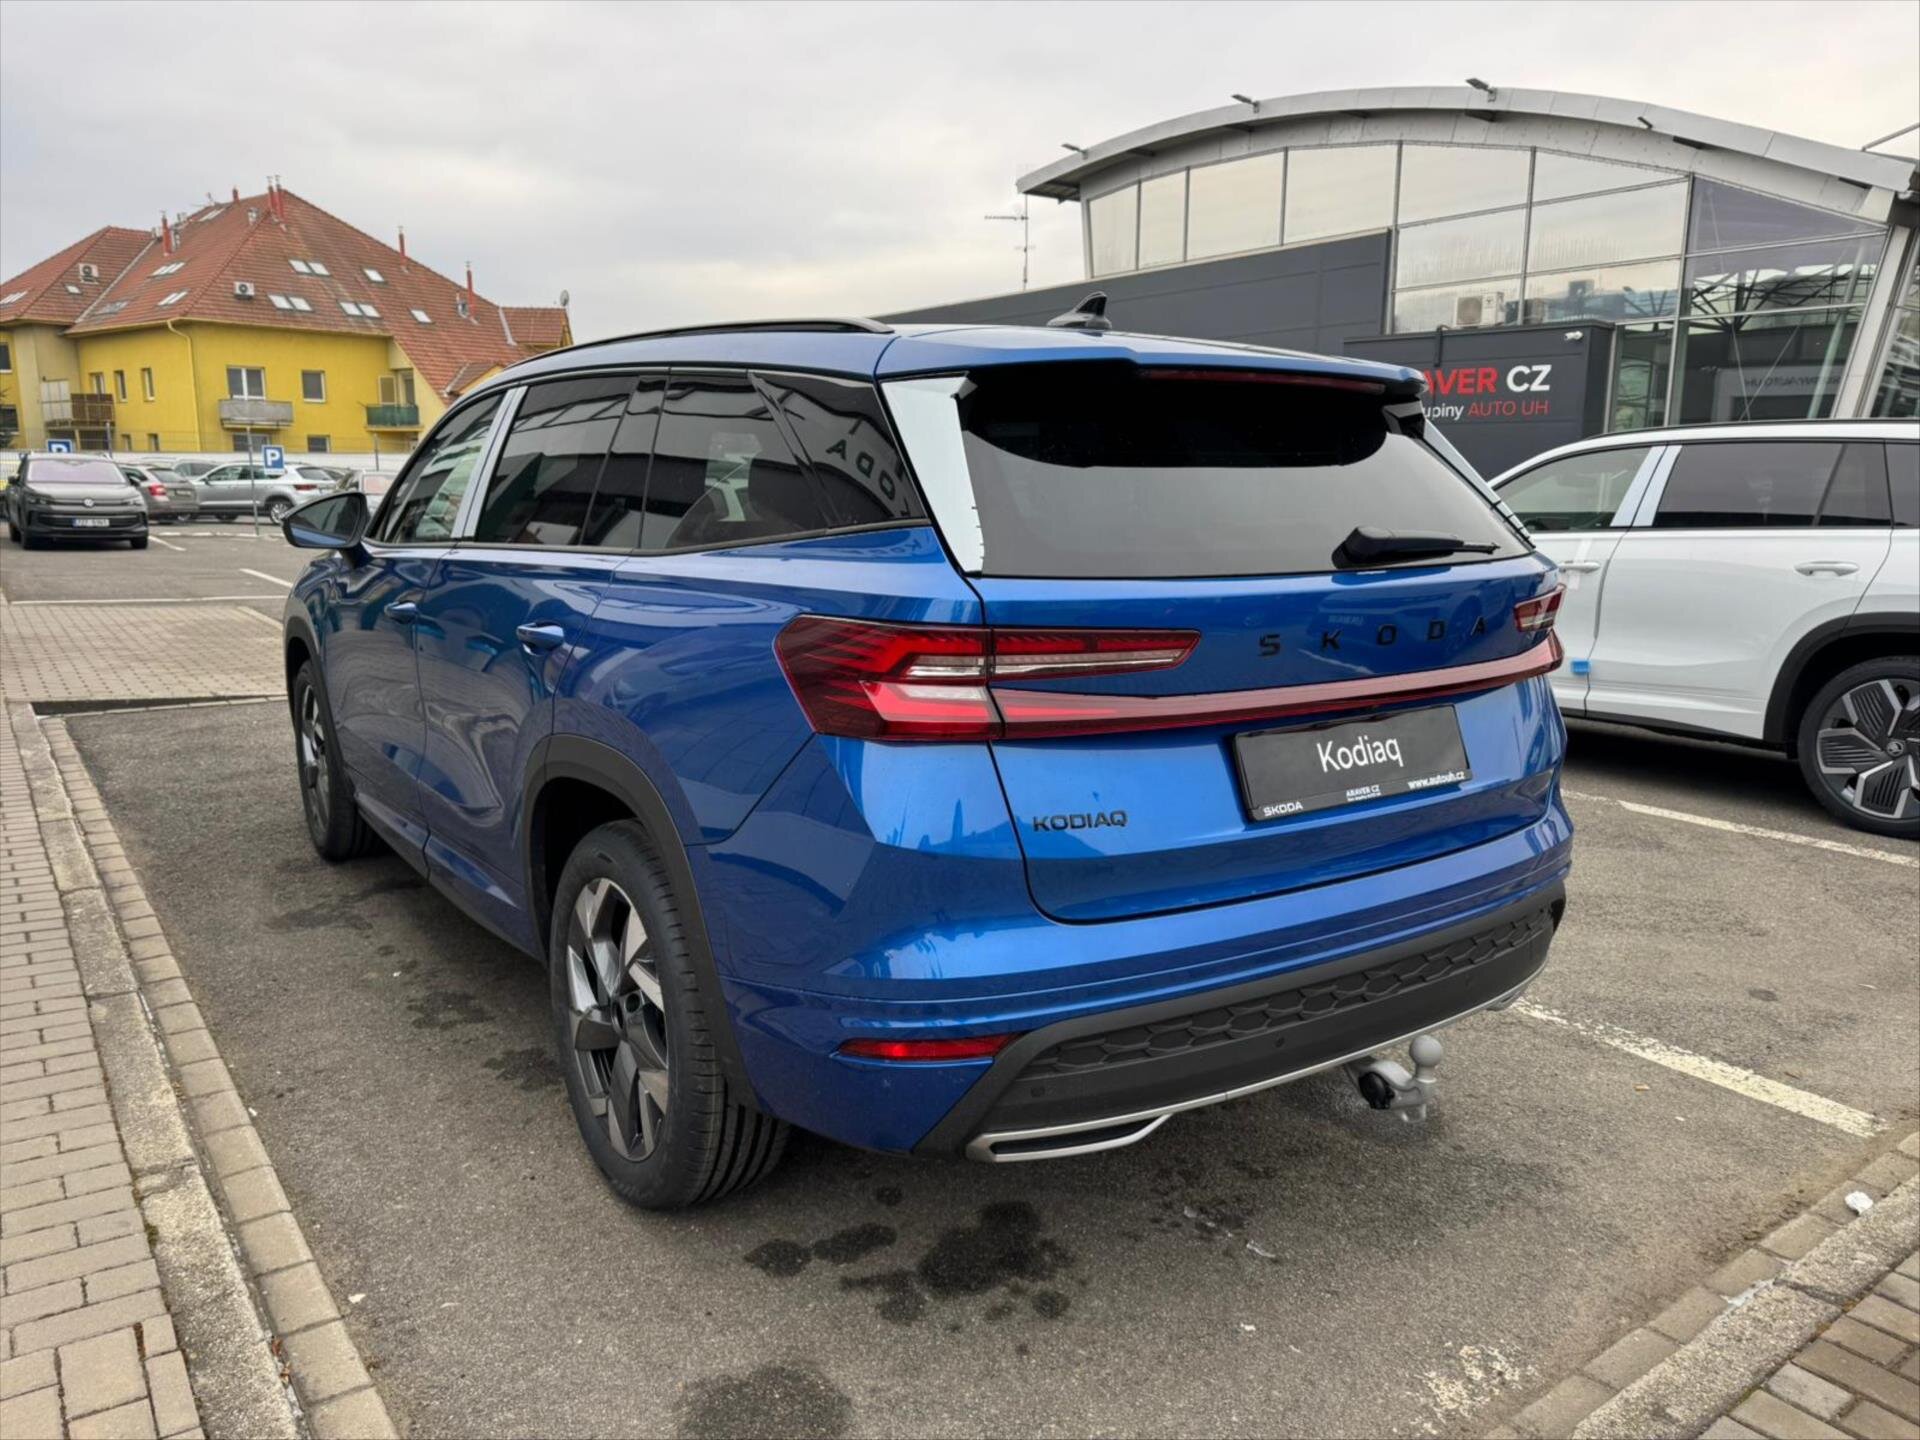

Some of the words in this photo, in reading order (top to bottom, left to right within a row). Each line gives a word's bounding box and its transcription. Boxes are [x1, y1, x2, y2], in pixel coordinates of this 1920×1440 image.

[1506, 364, 1552, 393] CZ
[1468, 400, 1517, 417] AUTO
[1521, 399, 1550, 416] UH
[265, 448, 281, 467] P
[1316, 735, 1404, 773] Kodiaq
[1033, 810, 1128, 832] KODIAQ
